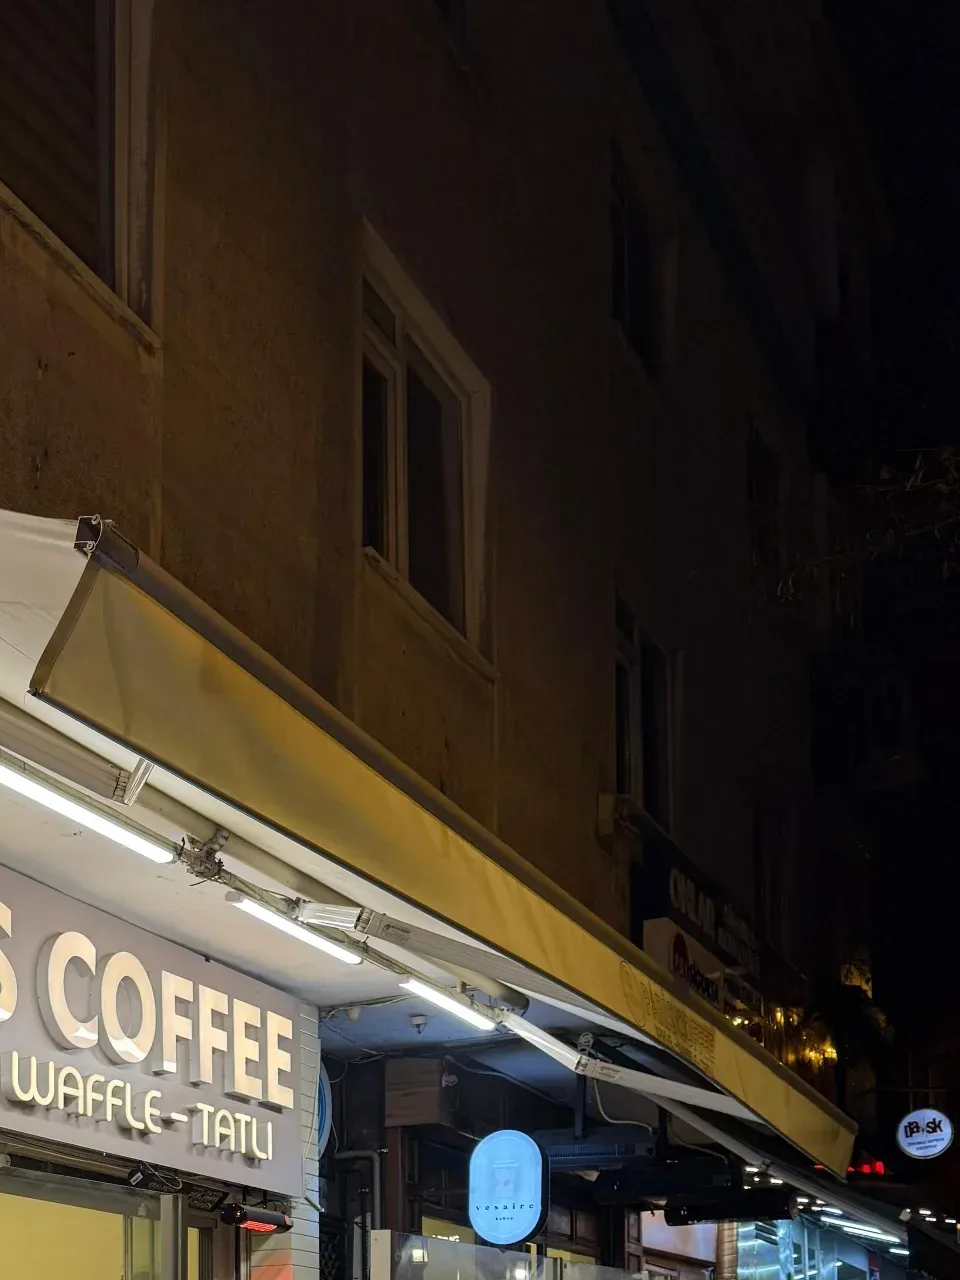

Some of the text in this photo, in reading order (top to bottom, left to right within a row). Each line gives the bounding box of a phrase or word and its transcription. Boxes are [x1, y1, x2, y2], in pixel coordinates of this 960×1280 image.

[46, 931, 295, 1109] COFFEE
[10, 1051, 163, 1136] WAFFLE
[195, 1102, 274, 1162] TATLI
